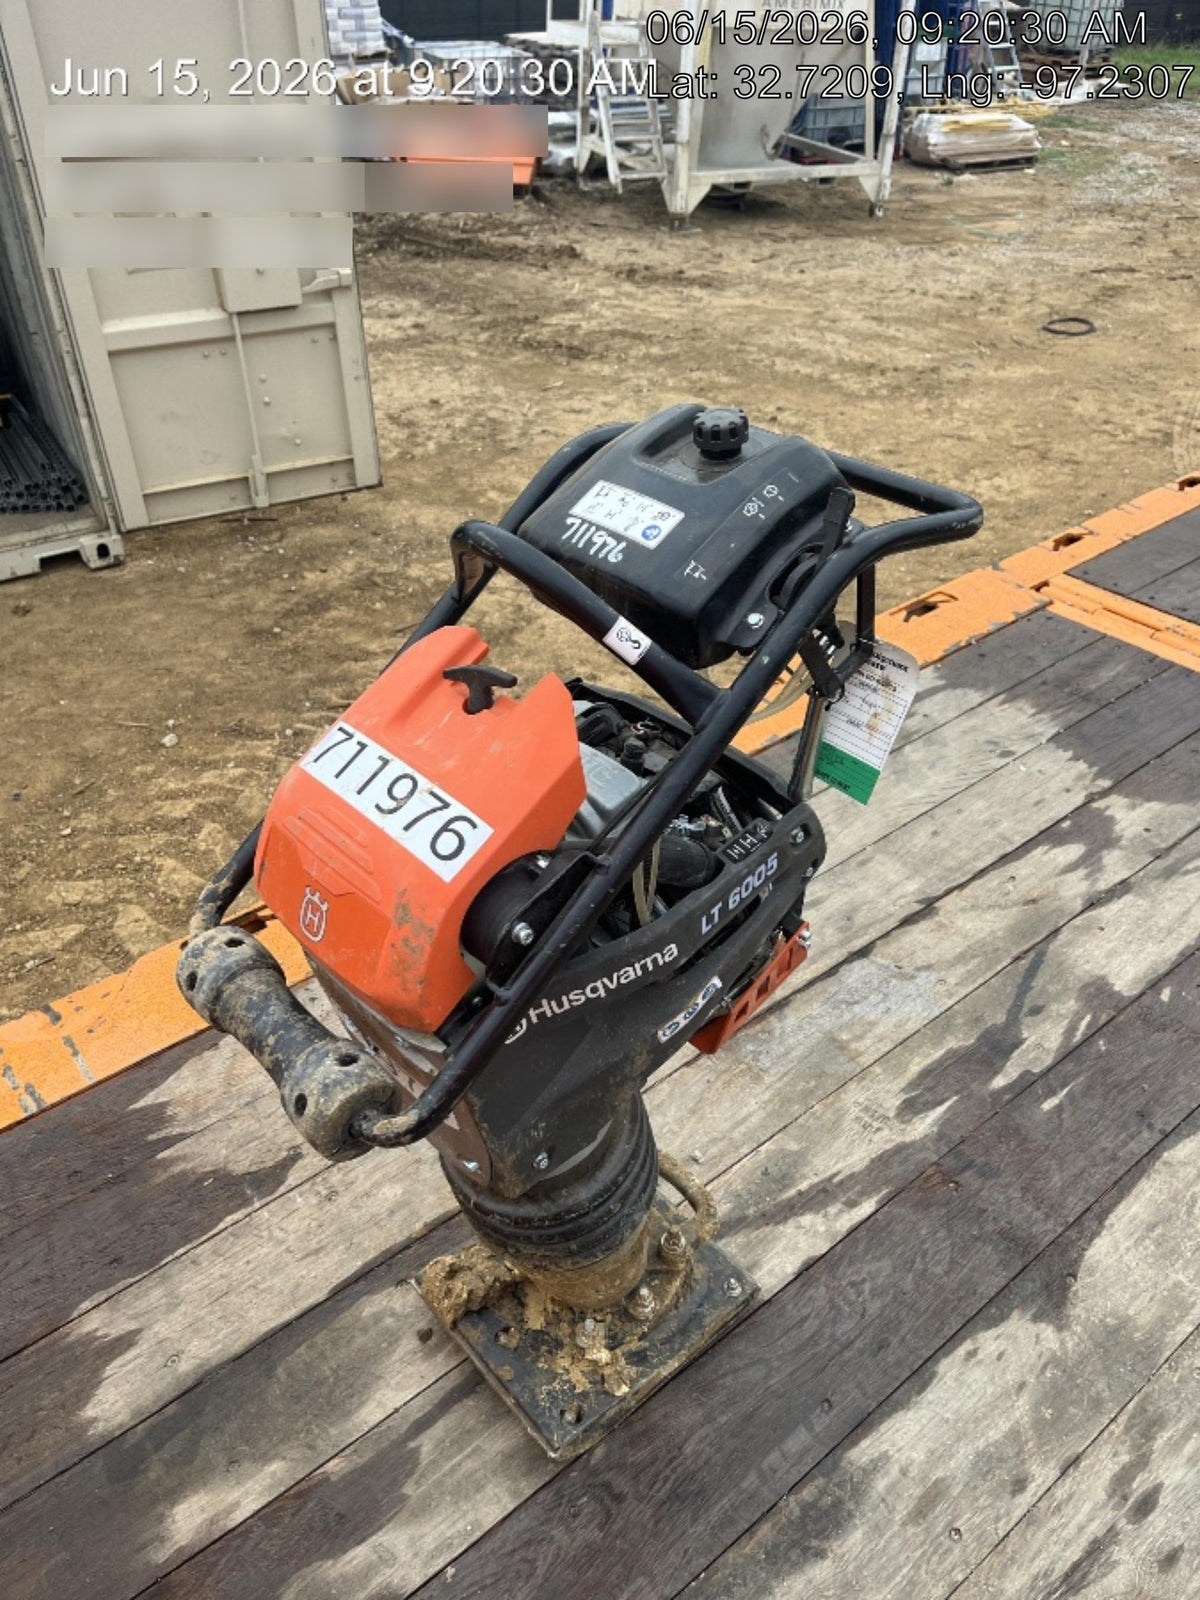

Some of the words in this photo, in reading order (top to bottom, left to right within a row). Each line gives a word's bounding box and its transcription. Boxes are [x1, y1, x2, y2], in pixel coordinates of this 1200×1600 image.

[561, 516, 627, 563] 711976
[313, 726, 479, 862] 711976
[701, 901, 723, 935] LT
[728, 852, 778, 911] 6005
[527, 943, 680, 1025] Husqvarna
